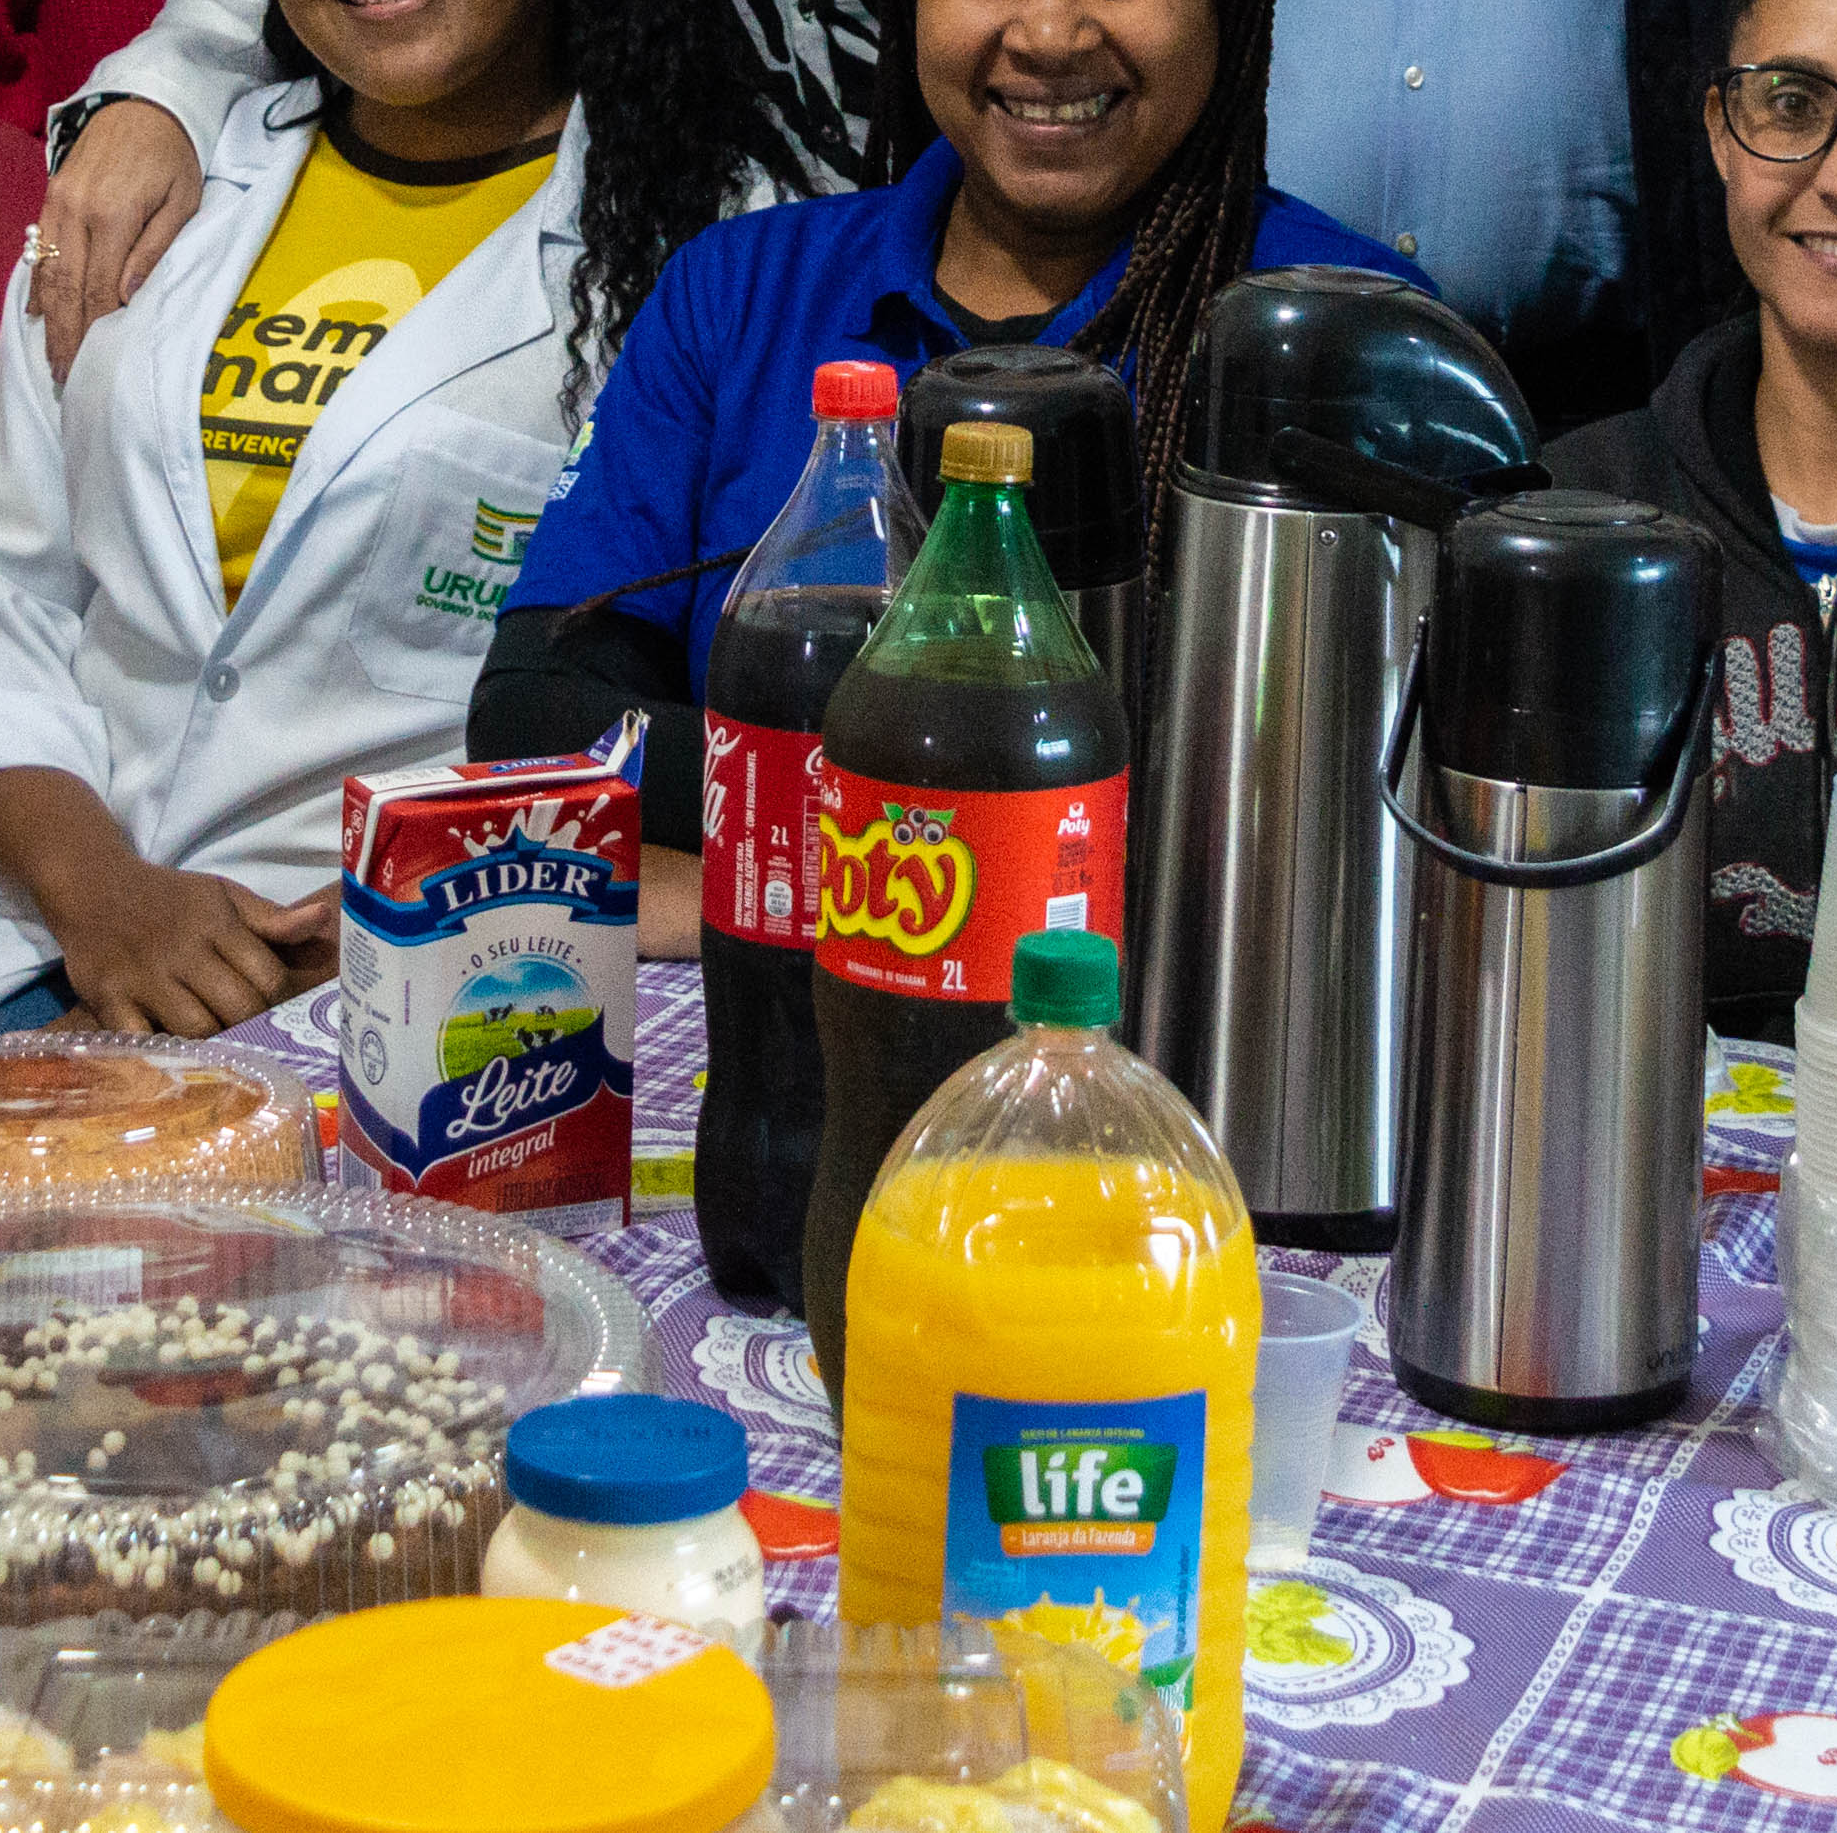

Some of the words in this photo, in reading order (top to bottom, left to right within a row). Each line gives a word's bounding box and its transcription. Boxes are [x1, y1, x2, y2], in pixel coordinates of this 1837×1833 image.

[770, 825, 790, 846] 2L
[1057, 817, 1091, 836] Poty
[441, 861, 591, 912] LIDER
[470, 953, 484, 970] O
[487, 938, 520, 960] SEU
[527, 935, 574, 961] LEITE
[942, 959, 967, 991] 2L
[446, 1053, 578, 1141] Leite
[467, 1121, 556, 1180] integral
[1019, 1449, 1144, 1517] life
[1022, 1528, 1069, 1548] Laranja
[1072, 1527, 1086, 1544] da
[1089, 1526, 1136, 1546] Fazenda
